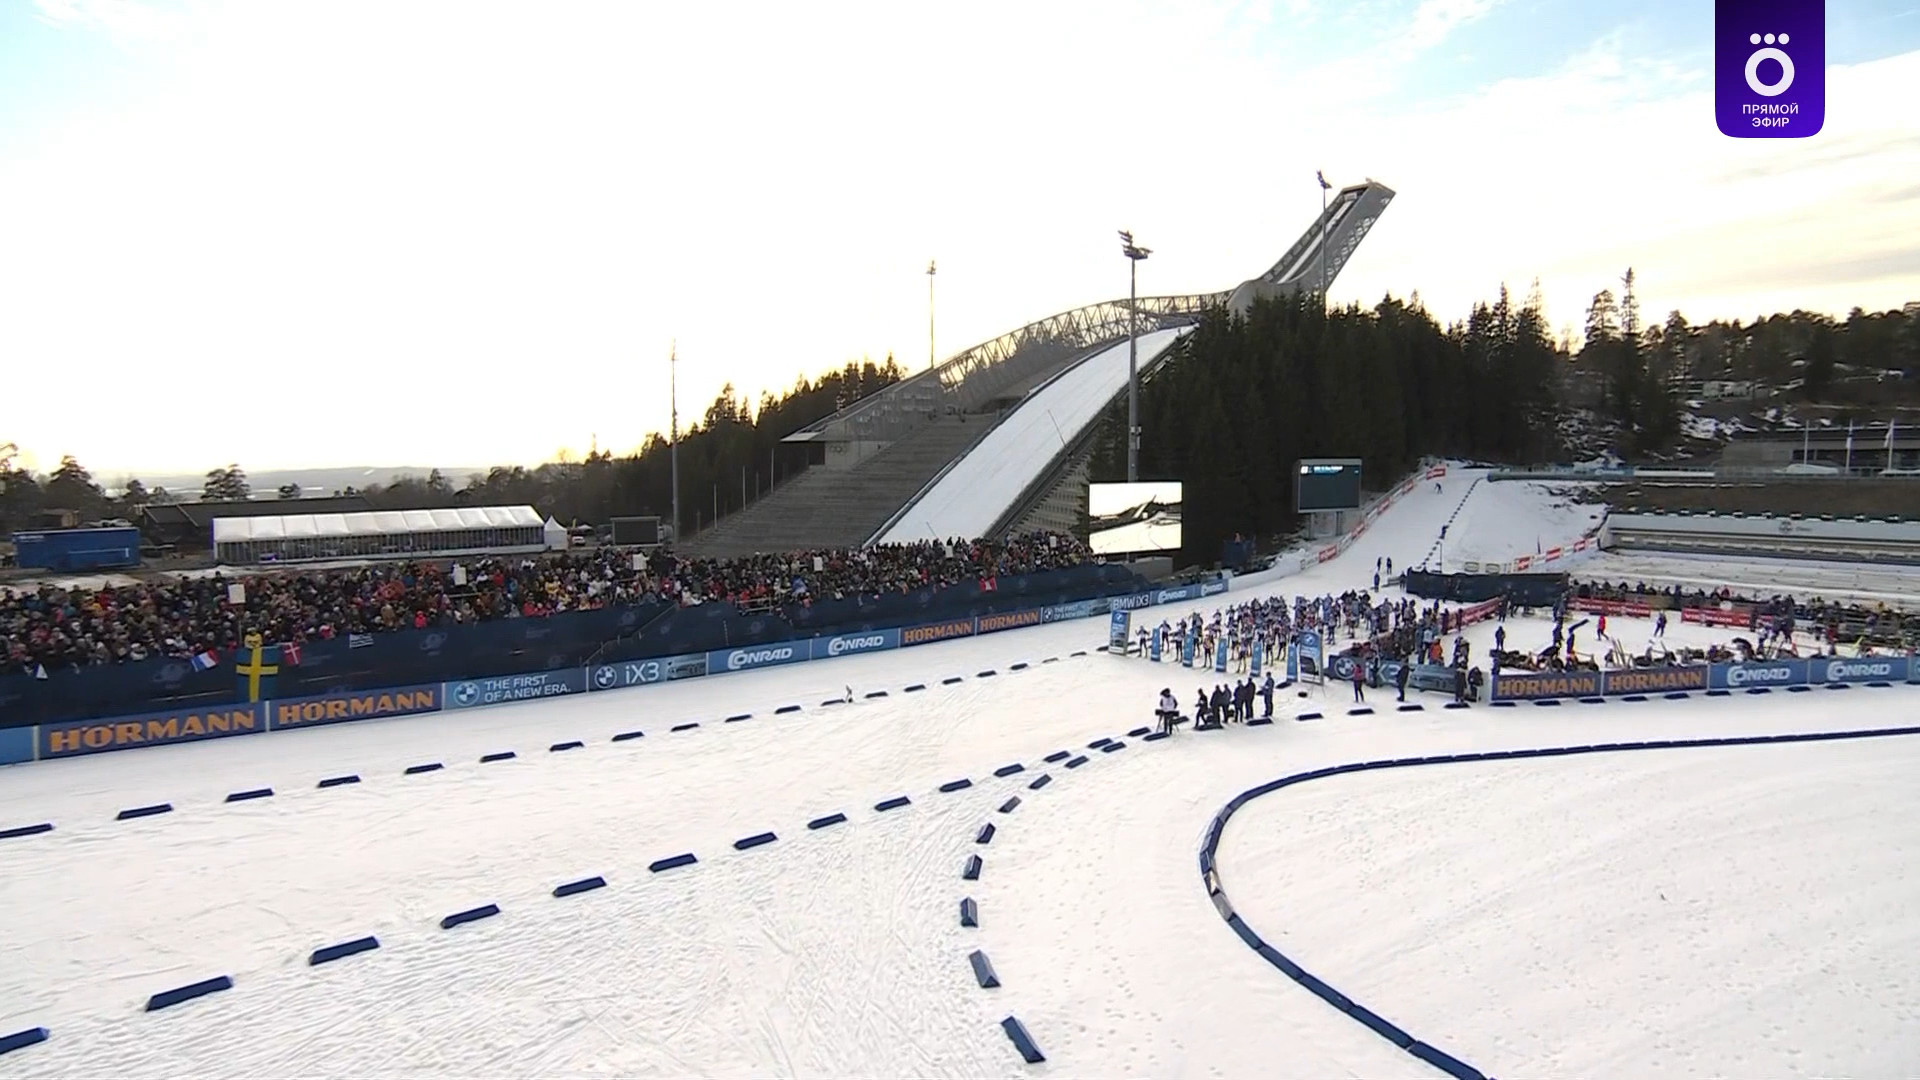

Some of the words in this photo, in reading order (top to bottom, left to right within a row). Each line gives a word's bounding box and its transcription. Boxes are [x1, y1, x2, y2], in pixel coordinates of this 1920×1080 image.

[1113, 598, 1134, 610] BMW
[1135, 594, 1149, 607] iX3
[904, 621, 973, 643] HÖRMANN
[828, 635, 884, 656] CONRAD
[727, 647, 793, 670] CONRAD
[625, 662, 660, 685] iX3
[1607, 671, 1701, 692] HÖRMANN
[1726, 664, 1792, 686] CONRAD
[1827, 660, 1892, 682] CONRAD
[484, 679, 510, 691] THE
[514, 675, 548, 688] FIRST
[484, 690, 502, 703] OF
[503, 690, 513, 701] A
[514, 686, 543, 699] NEW
[544, 683, 572, 695] ERA.
[1497, 677, 1596, 697] HÖRMANN
[278, 690, 434, 726] HÖRMANN
[50, 709, 256, 754] HÖRMANN
